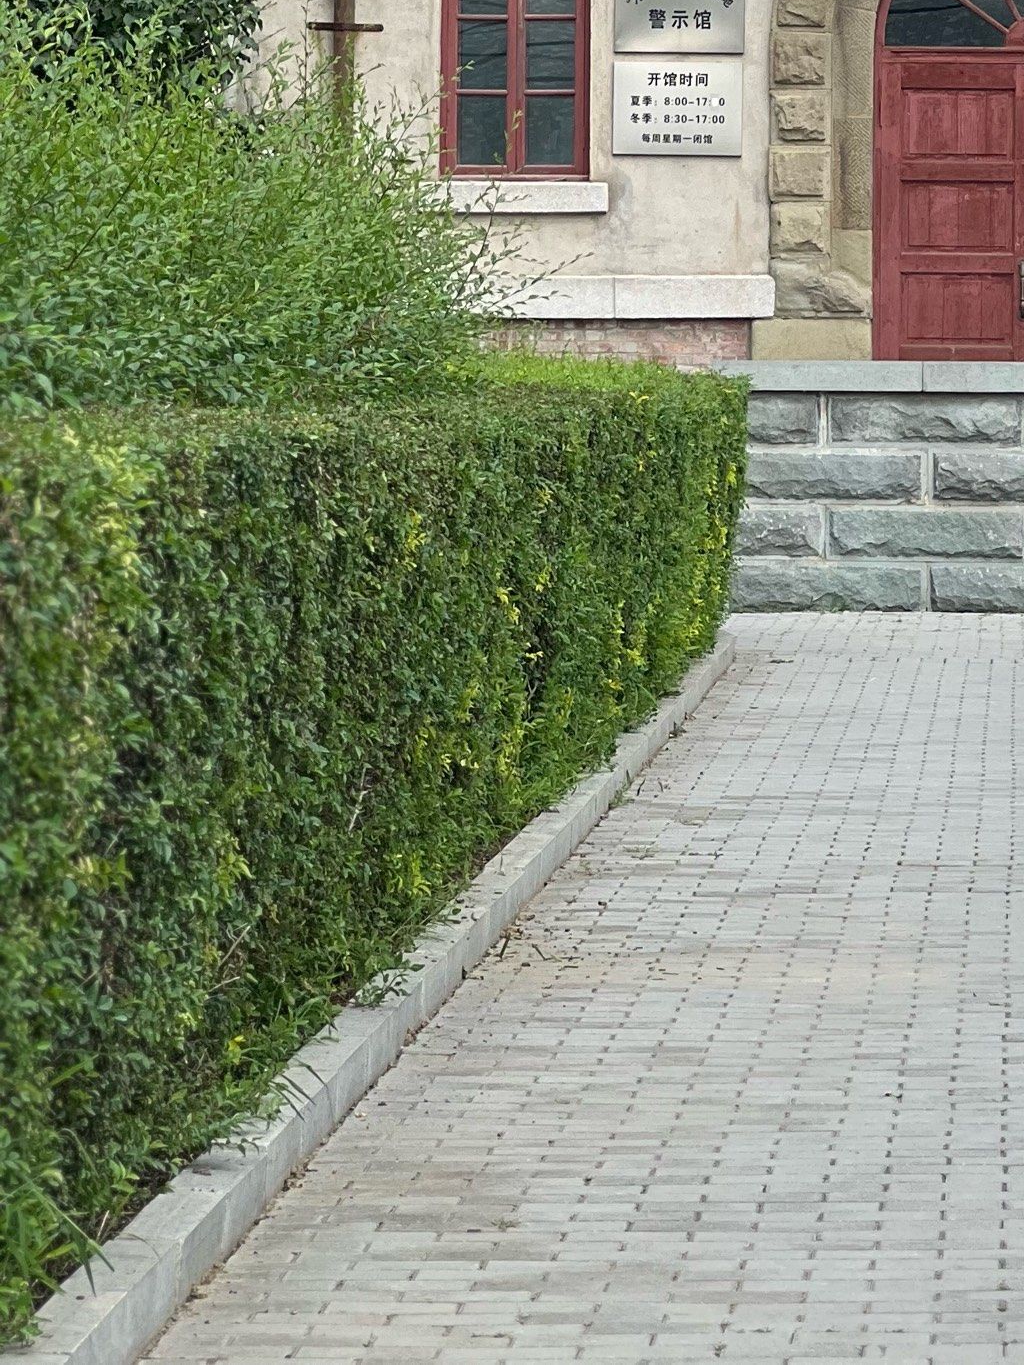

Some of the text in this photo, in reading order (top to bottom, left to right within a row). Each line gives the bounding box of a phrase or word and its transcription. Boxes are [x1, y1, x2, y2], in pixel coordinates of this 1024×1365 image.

[649, 10, 711, 29] 警示馆
[648, 73, 709, 86] 开馆时间
[642, 134, 713, 144] 每周星期一闭馆
